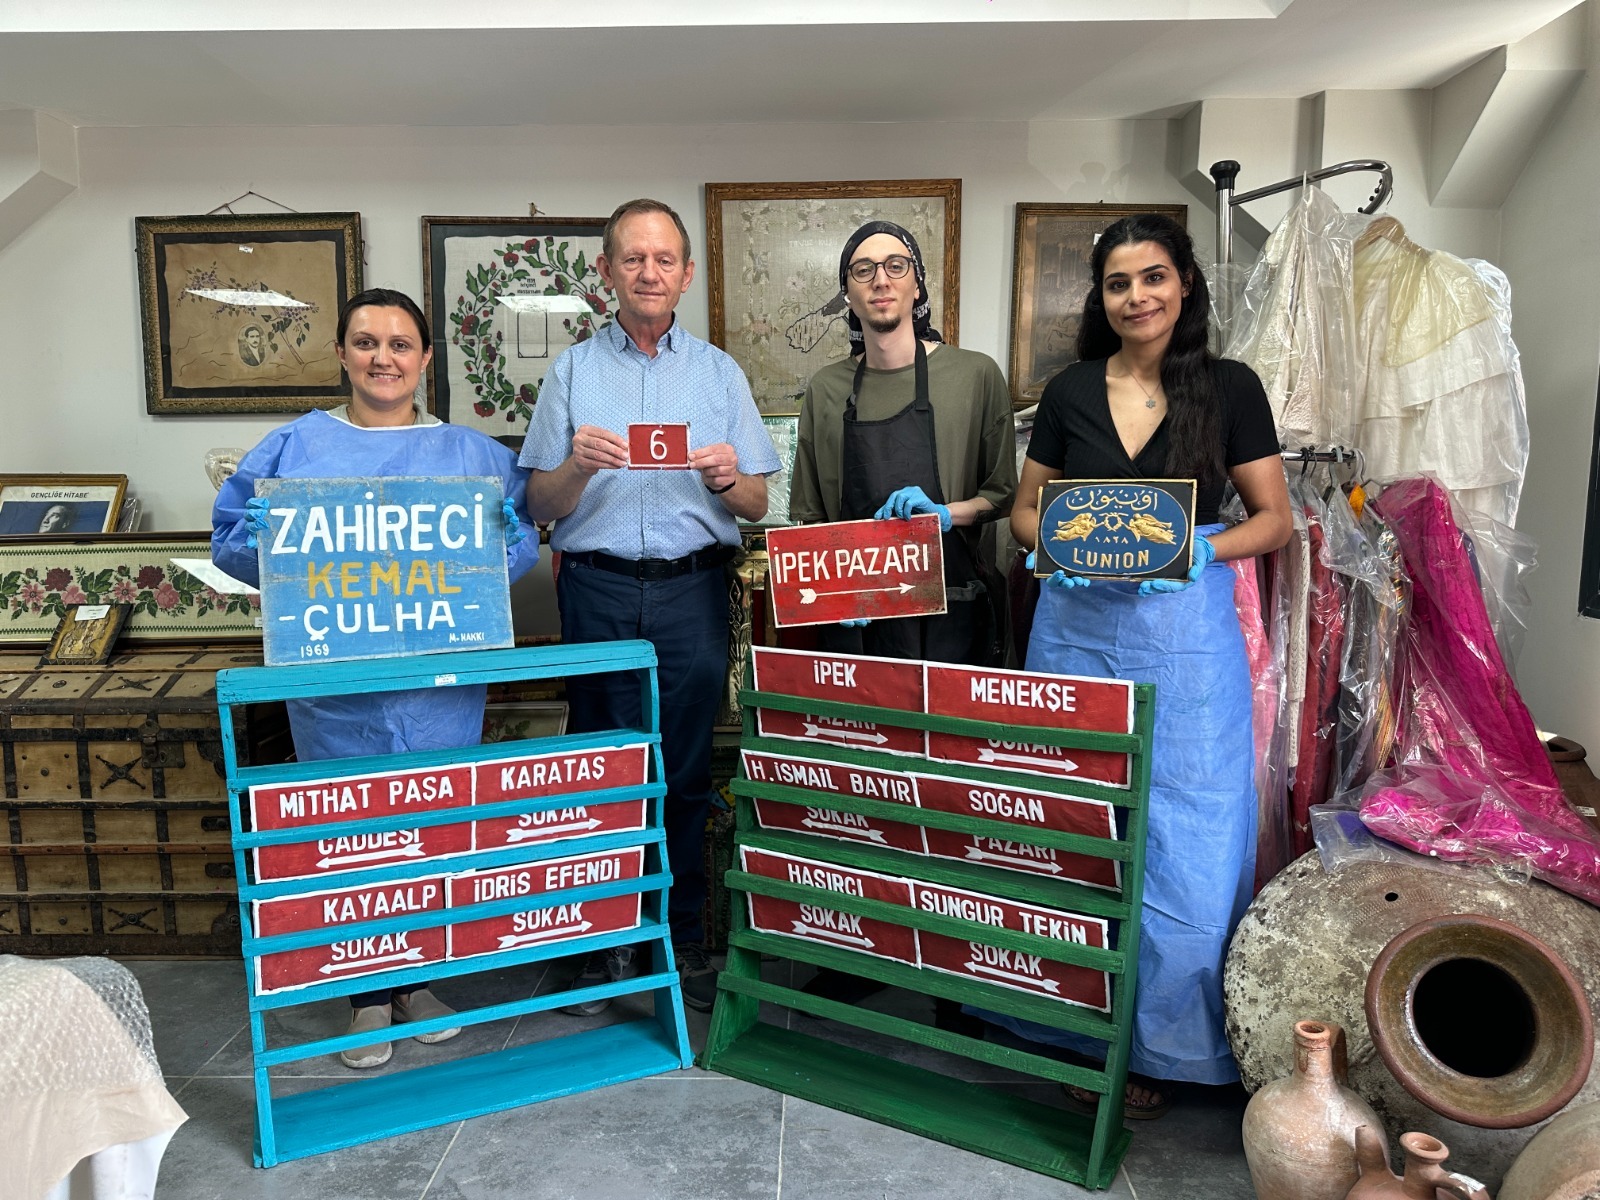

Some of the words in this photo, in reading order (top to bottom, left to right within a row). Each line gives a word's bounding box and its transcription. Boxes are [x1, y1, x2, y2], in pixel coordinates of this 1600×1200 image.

[650, 429, 668, 460] 6
[30, 491, 63, 499] GENÇLİĞE
[270, 491, 484, 555] ZAHİRECİ
[774, 546, 831, 584] İPEK
[834, 543, 929, 579] PAZARI
[1073, 547, 1149, 569] L'UNION
[308, 560, 462, 599] KEMAL
[303, 600, 456, 641] ÇULHA
[460, 632, 485, 642] HAKKI
[300, 644, 331, 658] 1969
[813, 660, 857, 688] İPEK
[970, 677, 1077, 713] MENEKŞE
[501, 755, 606, 792] KARATAŞ
[849, 773, 912, 803] BAYIR
[279, 782, 372, 819] MİTHAT
[388, 775, 454, 806] PAŞA
[968, 789, 1046, 823] SOĞAN
[473, 871, 531, 903] İDRİS
[545, 857, 621, 891] EFENDİ
[787, 863, 864, 898] HASIRCI
[323, 884, 437, 924] KAYAALP
[512, 901, 583, 933] SOKAK
[799, 903, 863, 936] SOKAK
[919, 890, 1004, 928] SUNGUR
[1018, 911, 1087, 945] TEKİN
[330, 931, 409, 961] SOKAK
[969, 941, 1043, 977] SOKAK
